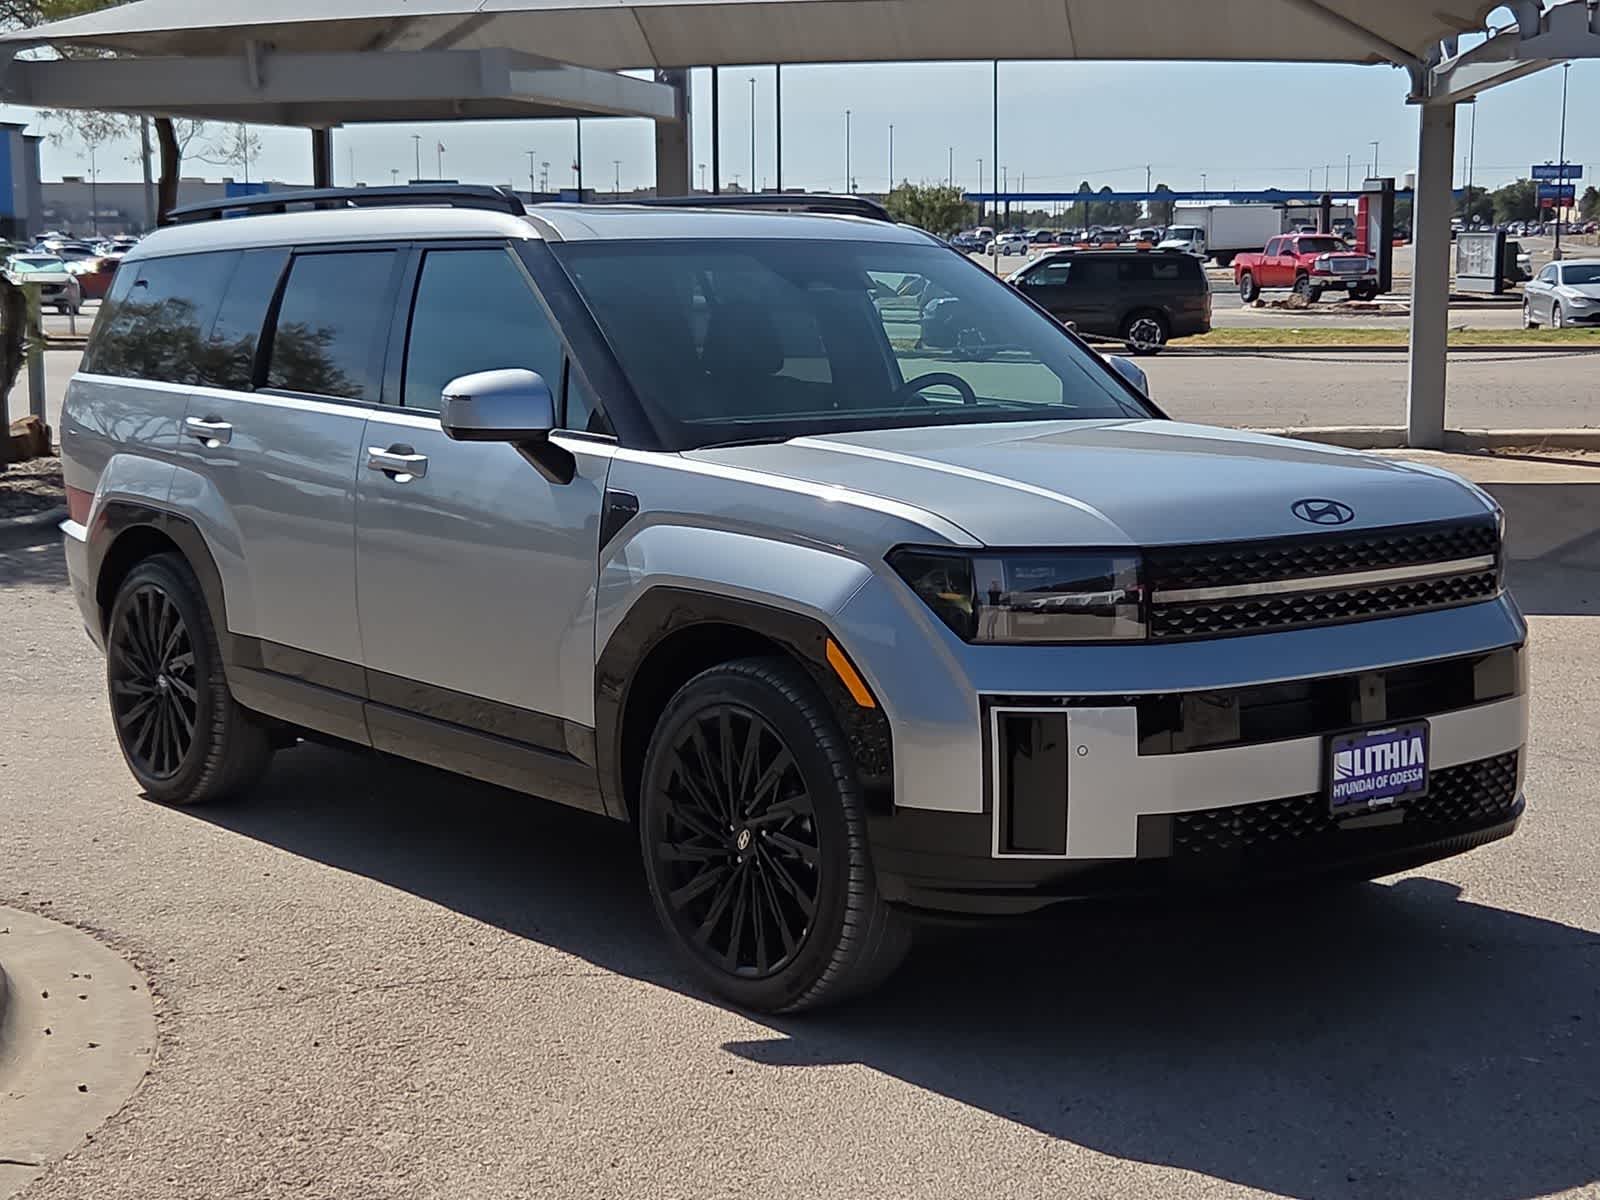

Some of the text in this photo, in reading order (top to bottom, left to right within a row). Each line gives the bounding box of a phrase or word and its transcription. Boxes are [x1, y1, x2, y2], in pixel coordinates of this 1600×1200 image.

[1353, 737, 1425, 776] LITHIA
[1333, 768, 1423, 798] HYUNDAI OF ODESSA
